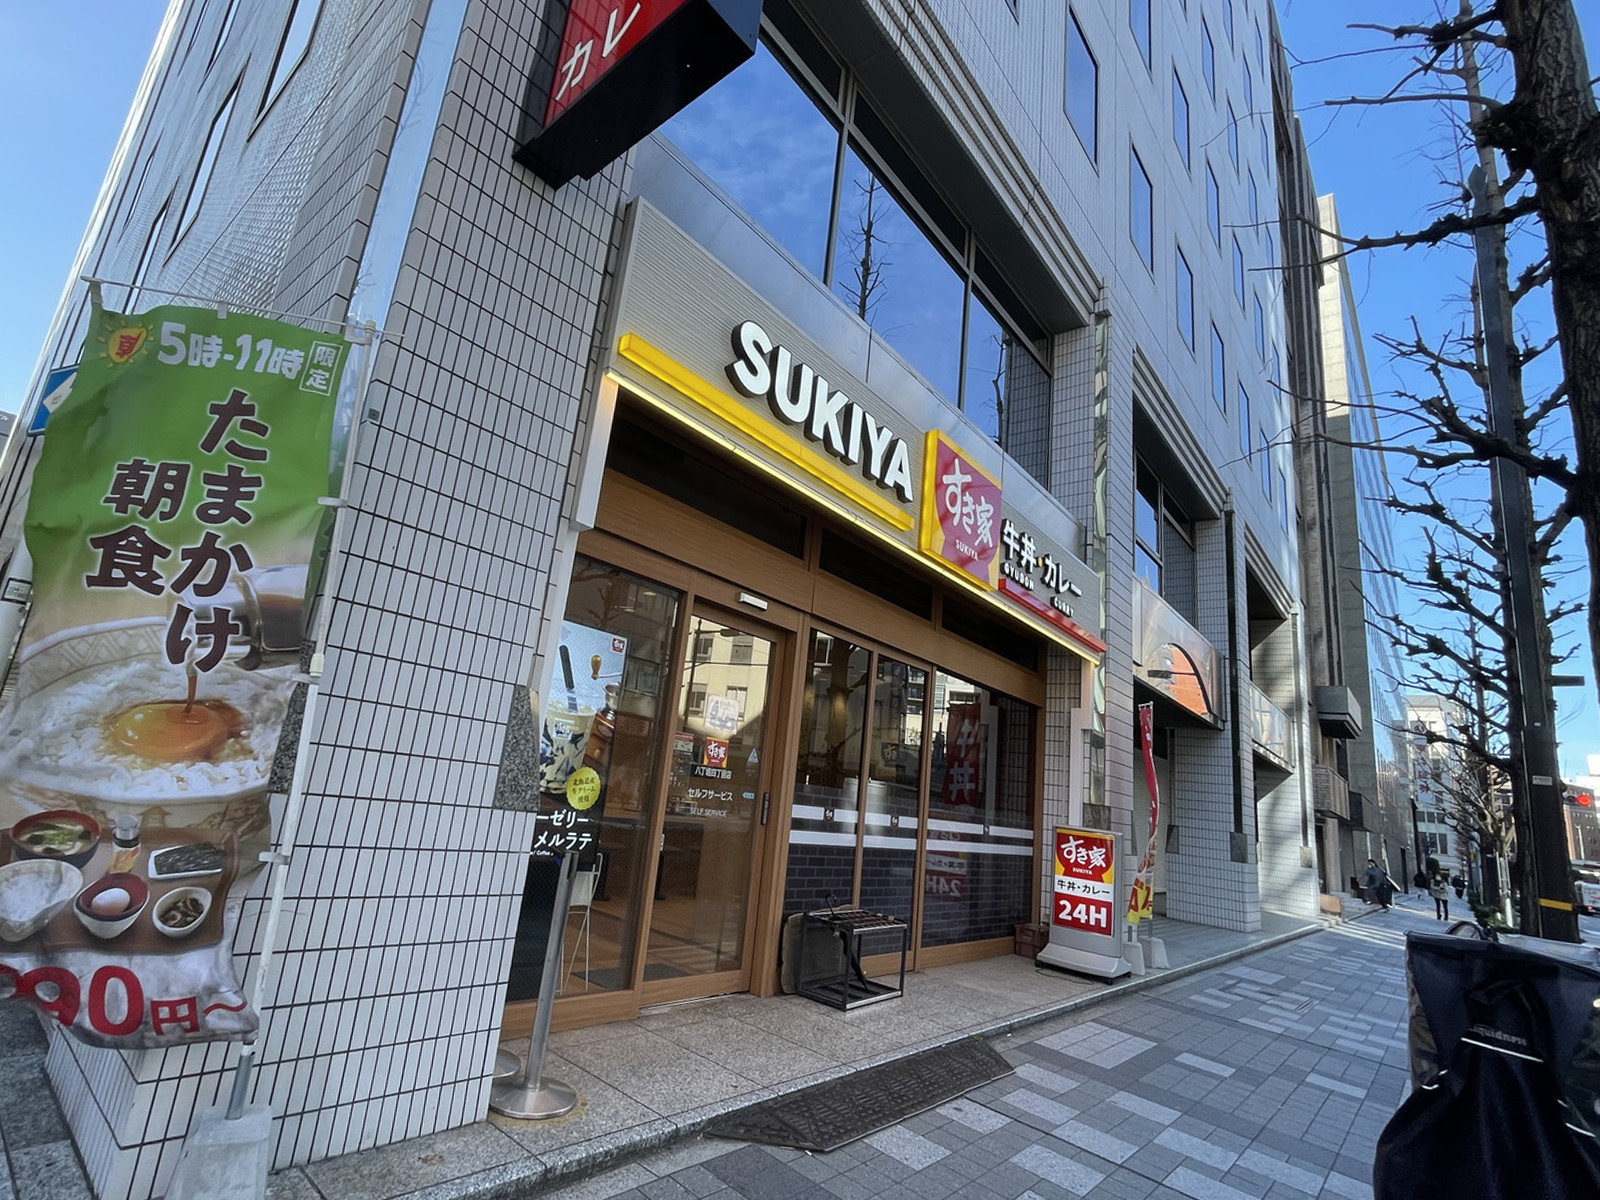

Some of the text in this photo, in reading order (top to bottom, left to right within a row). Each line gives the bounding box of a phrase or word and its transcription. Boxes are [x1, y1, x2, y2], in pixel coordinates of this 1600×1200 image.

[306, 345, 334, 390] 限定
[731, 319, 914, 503] SUKIYA
[942, 458, 994, 548] すき家
[85, 458, 192, 596] 朝食
[165, 388, 269, 673] たまかけ
[955, 538, 979, 562] SUKIYA
[1002, 519, 1082, 597] 牛丼・カレー
[1002, 561, 1035, 591] GYUDON
[688, 787, 733, 802] セルフサービス
[690, 807, 728, 818] SELF SERVICE
[1060, 836, 1107, 869] すき家
[1072, 866, 1093, 875] SUKIYA
[1057, 879, 1110, 895] 牛丼・カレー
[1058, 899, 1108, 928] 24H
